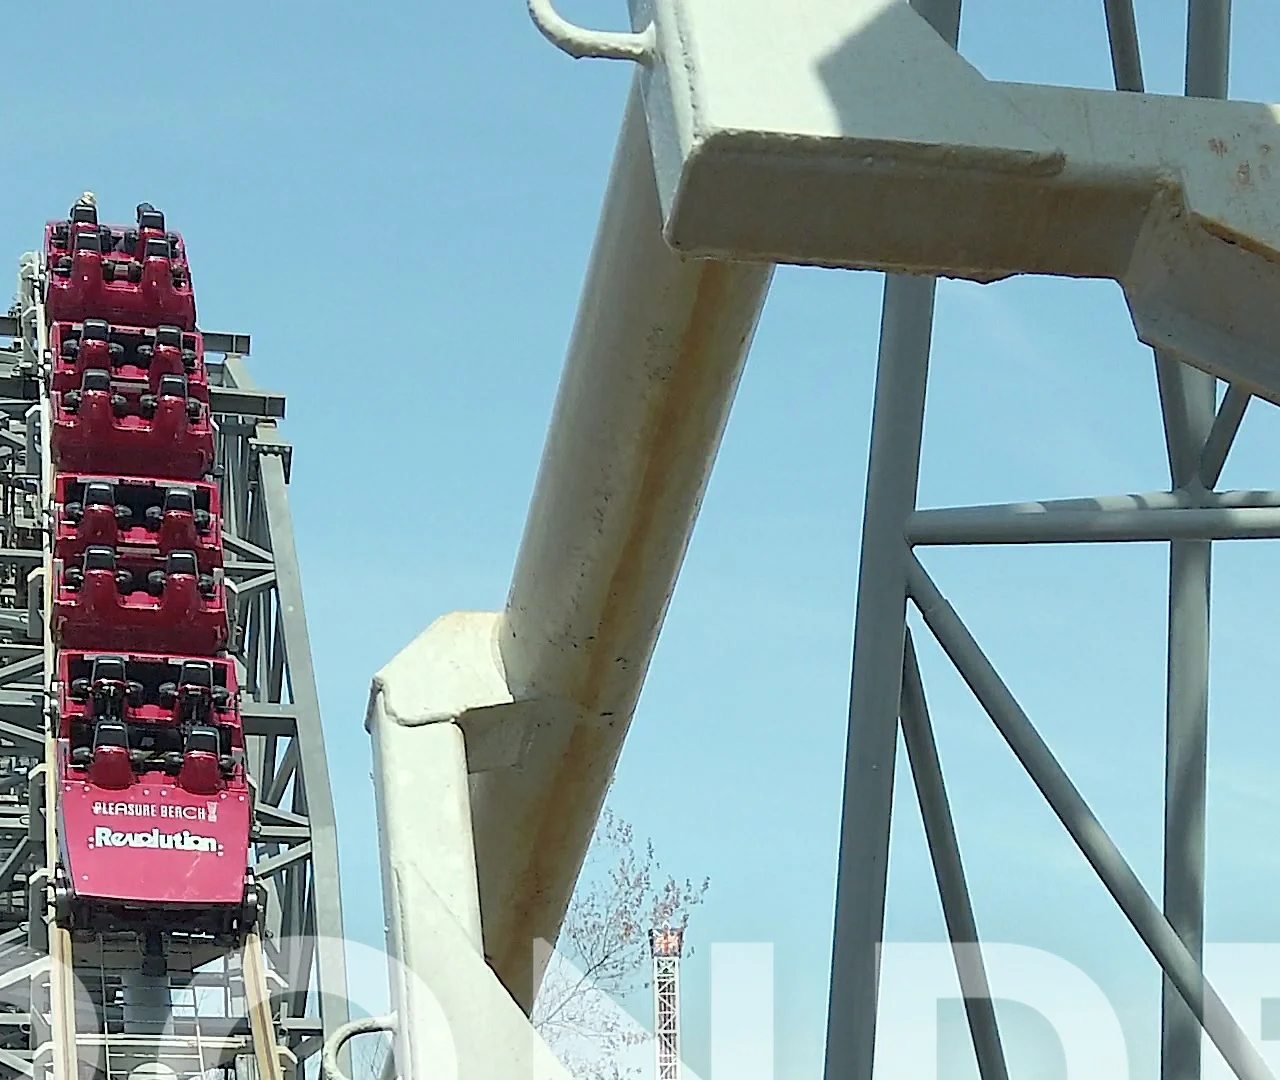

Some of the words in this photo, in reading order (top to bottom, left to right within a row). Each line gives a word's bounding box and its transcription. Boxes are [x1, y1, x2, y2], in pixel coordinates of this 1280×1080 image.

[92, 801, 157, 818] PLEASURE
[161, 805, 207, 820] BEACH
[94, 826, 217, 852] Revolution
